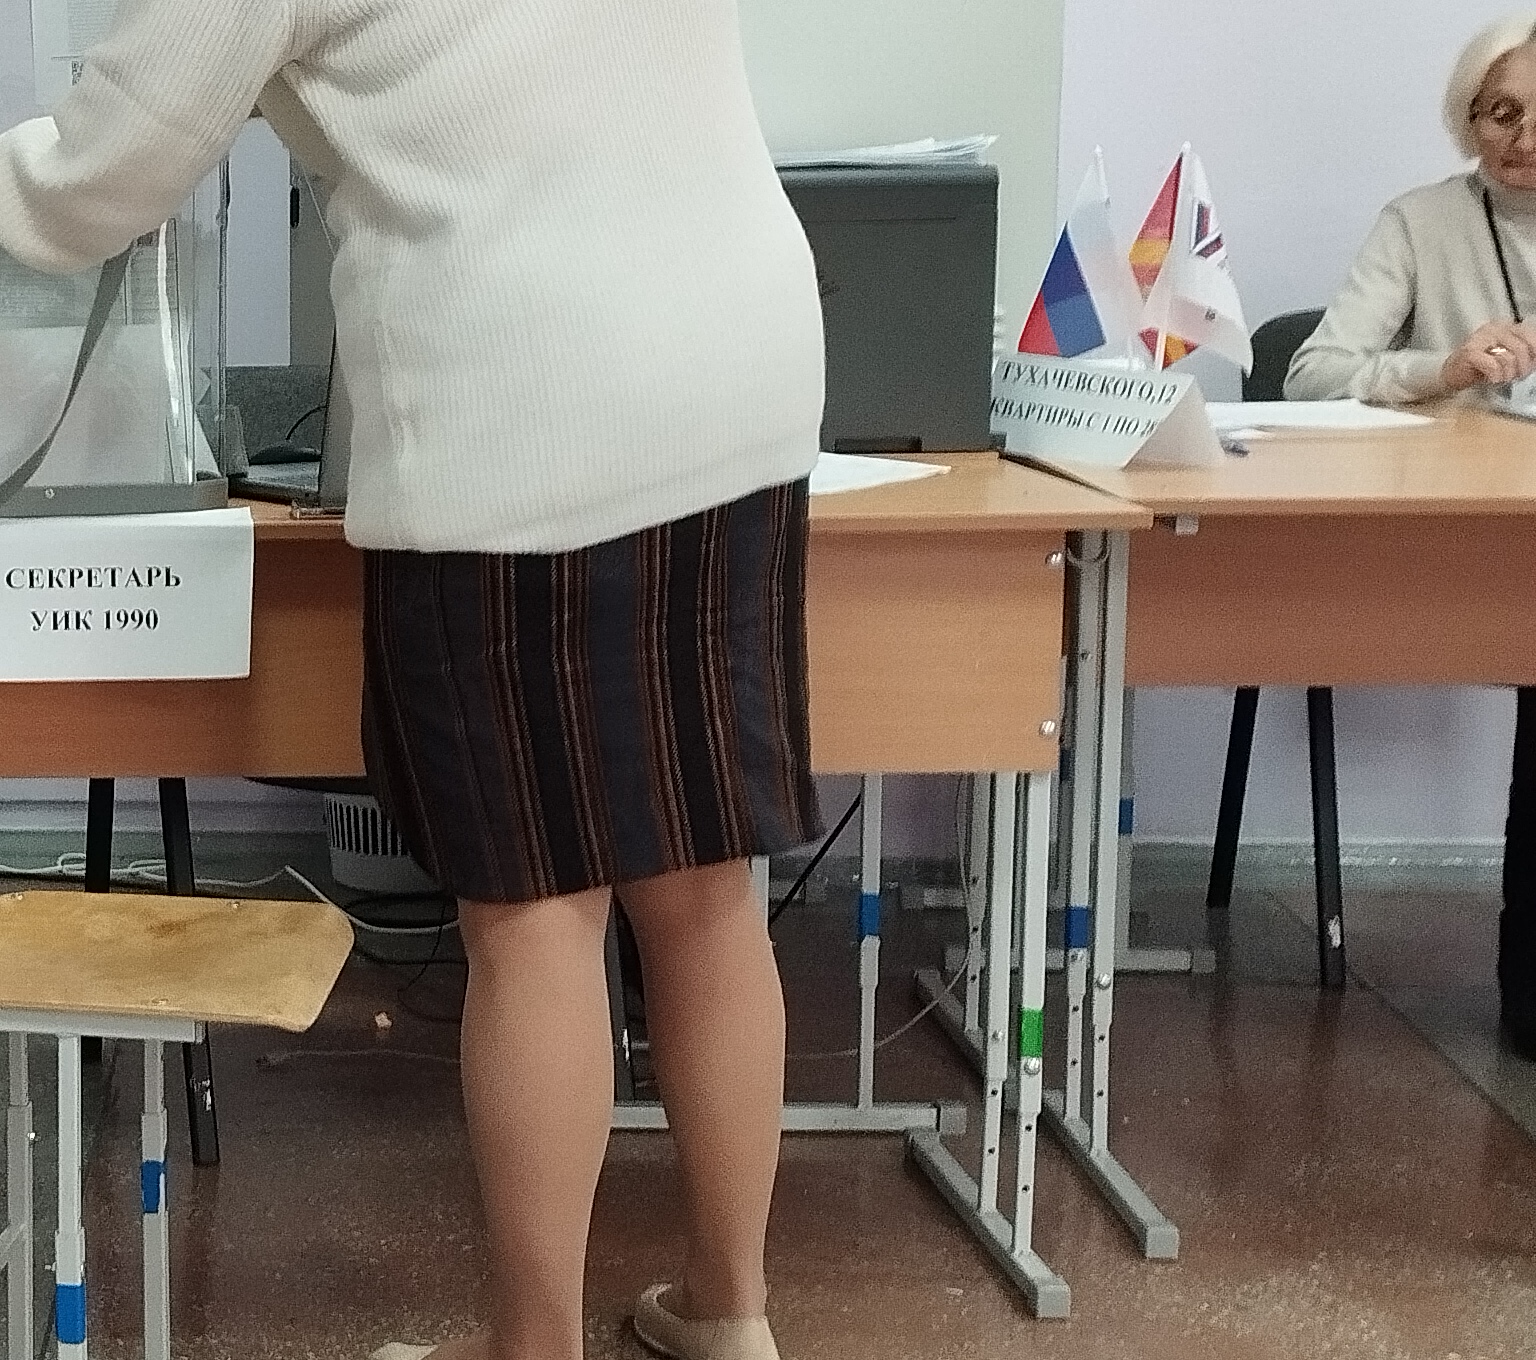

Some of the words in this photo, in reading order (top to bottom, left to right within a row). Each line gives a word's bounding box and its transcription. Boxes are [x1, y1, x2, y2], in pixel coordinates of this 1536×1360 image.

[1001, 359, 1178, 406] ТУХАЧЕВСКОГО,12
[990, 396, 1085, 428] КВАРТИРЫ
[1086, 412, 1101, 430] С
[1102, 414, 1111, 432] 1
[1113, 415, 1140, 436] ПО
[5, 566, 182, 590] СЕКРЕТАРЬ
[30, 609, 94, 631] УИК
[103, 608, 160, 631] 1990
